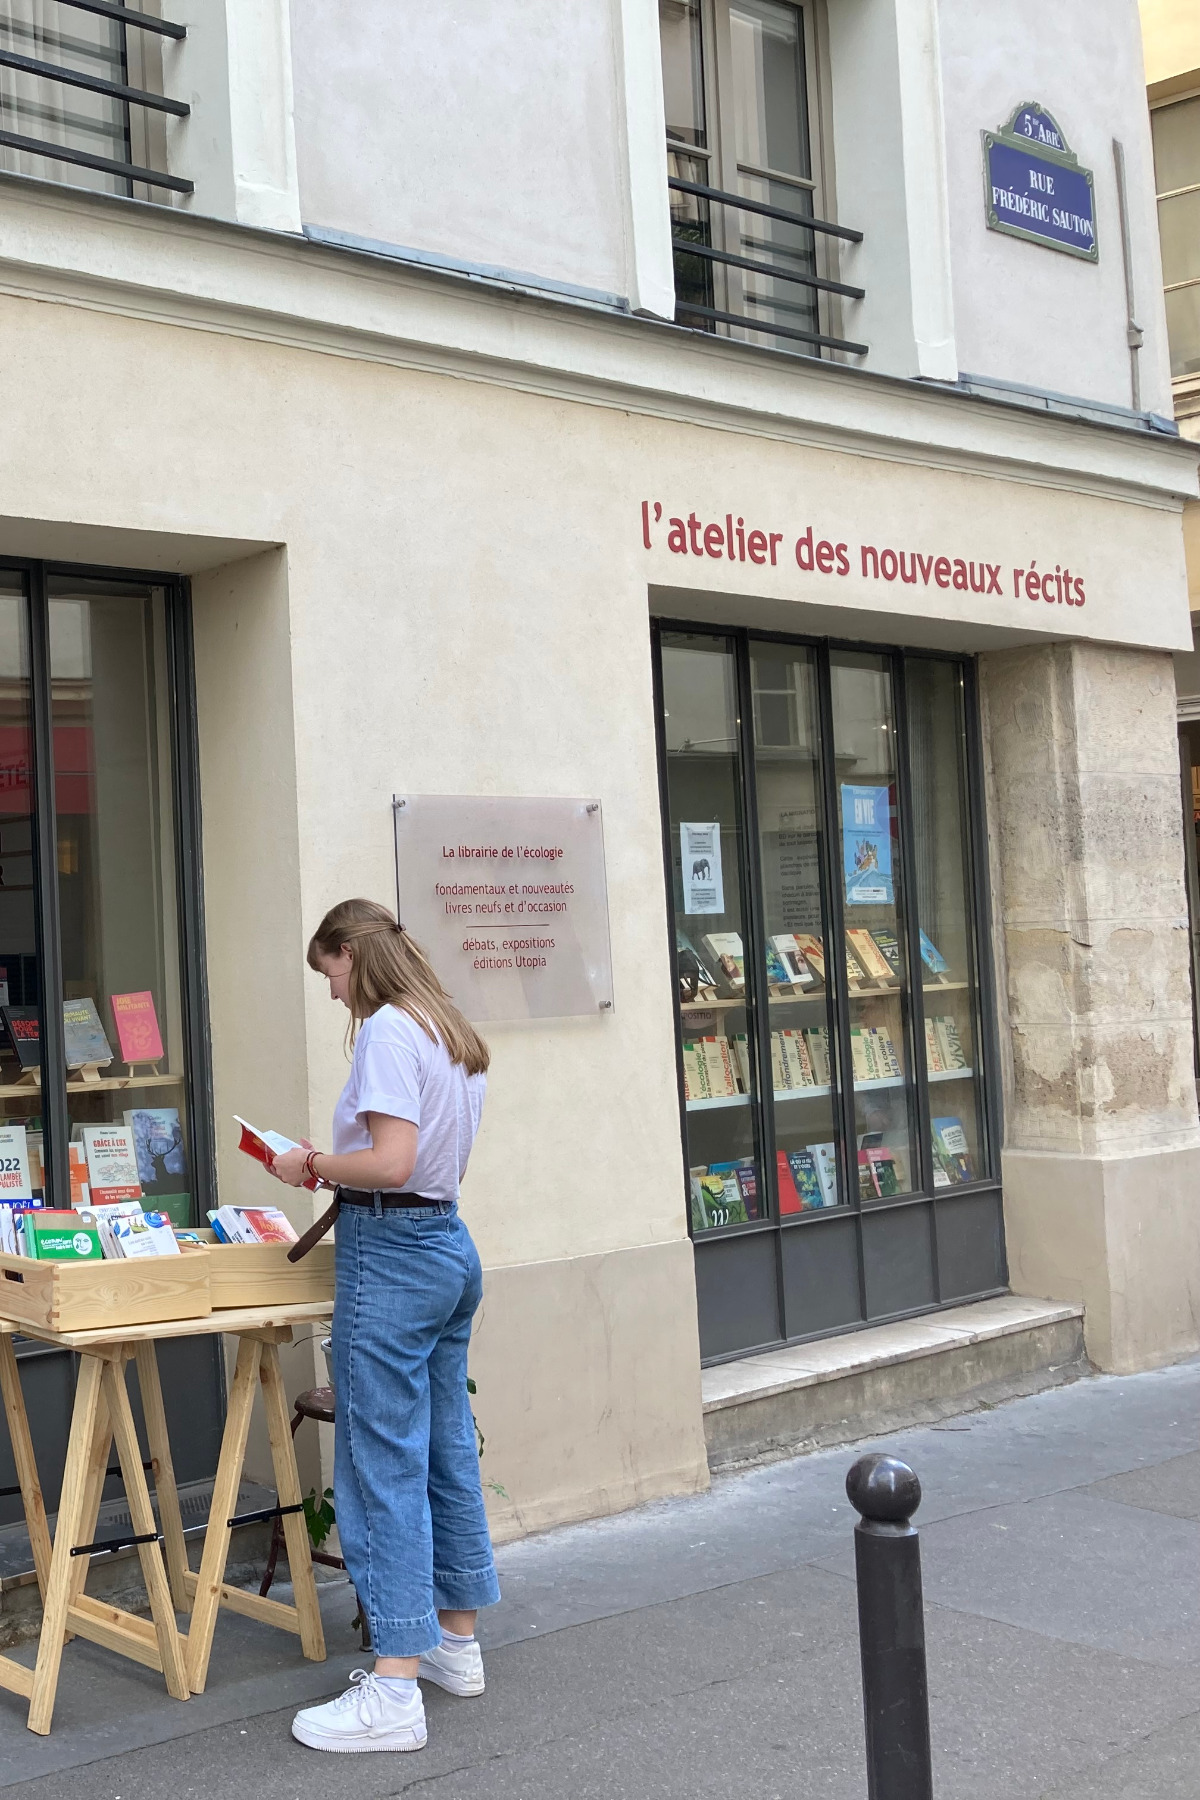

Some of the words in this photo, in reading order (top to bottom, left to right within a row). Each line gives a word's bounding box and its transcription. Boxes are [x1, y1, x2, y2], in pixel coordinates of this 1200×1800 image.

[1029, 169, 1055, 195] RUE
[992, 186, 1050, 222] FRÉDÉRIC
[1052, 207, 1094, 237] SAUTON
[794, 526, 850, 576] des
[860, 544, 1004, 596] nouveaux
[1012, 560, 1086, 607] récits
[443, 846, 455, 858] La
[458, 846, 498, 858] librairie
[501, 846, 514, 858] de
[435, 883, 506, 895] fondamentaux
[509, 885, 519, 894] et
[522, 881, 575, 894] nouveautés
[445, 901, 473, 914] livres
[475, 901, 502, 913] neufs
[505, 902, 515, 913] et
[462, 938, 499, 952] débats,
[502, 937, 556, 952] expositions
[473, 956, 513, 970] éditions
[515, 955, 547, 970] Utopia
[794, 1039, 803, 1070] voleurs
[878, 1036, 888, 1060] colère
[886, 1040, 896, 1056] joie
[927, 1033, 941, 1071] DETTE
[949, 1024, 965, 1069] VIVIR
[778, 1031, 792, 1090] effondrement
[884, 1062, 891, 1072] La
[93, 1139, 111, 1148] GRÂCE
